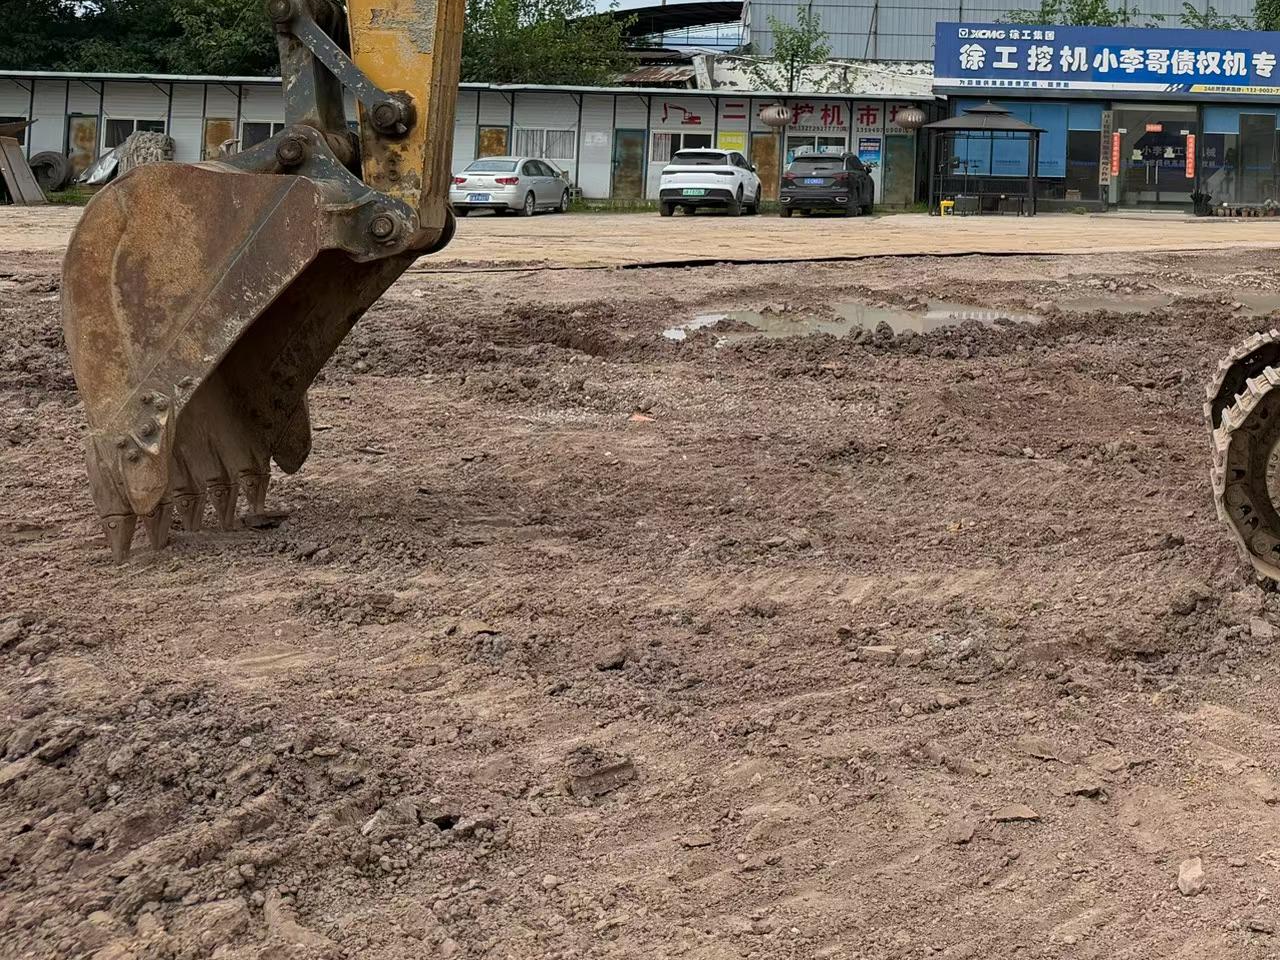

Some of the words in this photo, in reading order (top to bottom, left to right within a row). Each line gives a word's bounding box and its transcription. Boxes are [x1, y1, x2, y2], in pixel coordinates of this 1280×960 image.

[970, 29, 1006, 39] XCMG
[1009, 29, 1055, 40] 徐工集团
